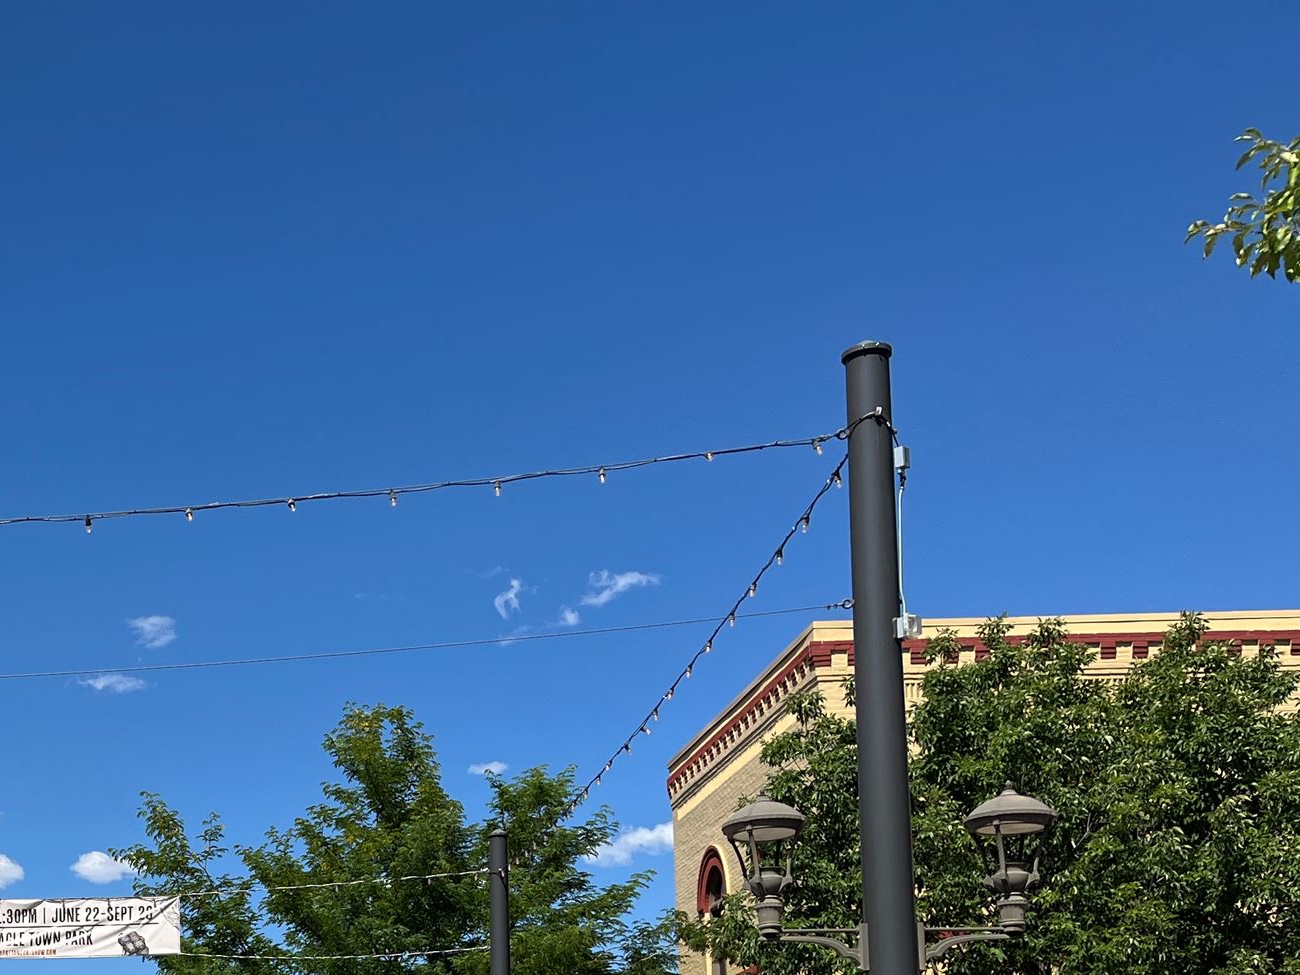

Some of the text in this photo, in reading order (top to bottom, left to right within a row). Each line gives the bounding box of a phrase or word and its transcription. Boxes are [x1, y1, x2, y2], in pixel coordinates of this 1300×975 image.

[51, 907, 81, 923] JUNE
[29, 931, 61, 947] TOWN
[65, 930, 93, 946] PARK
